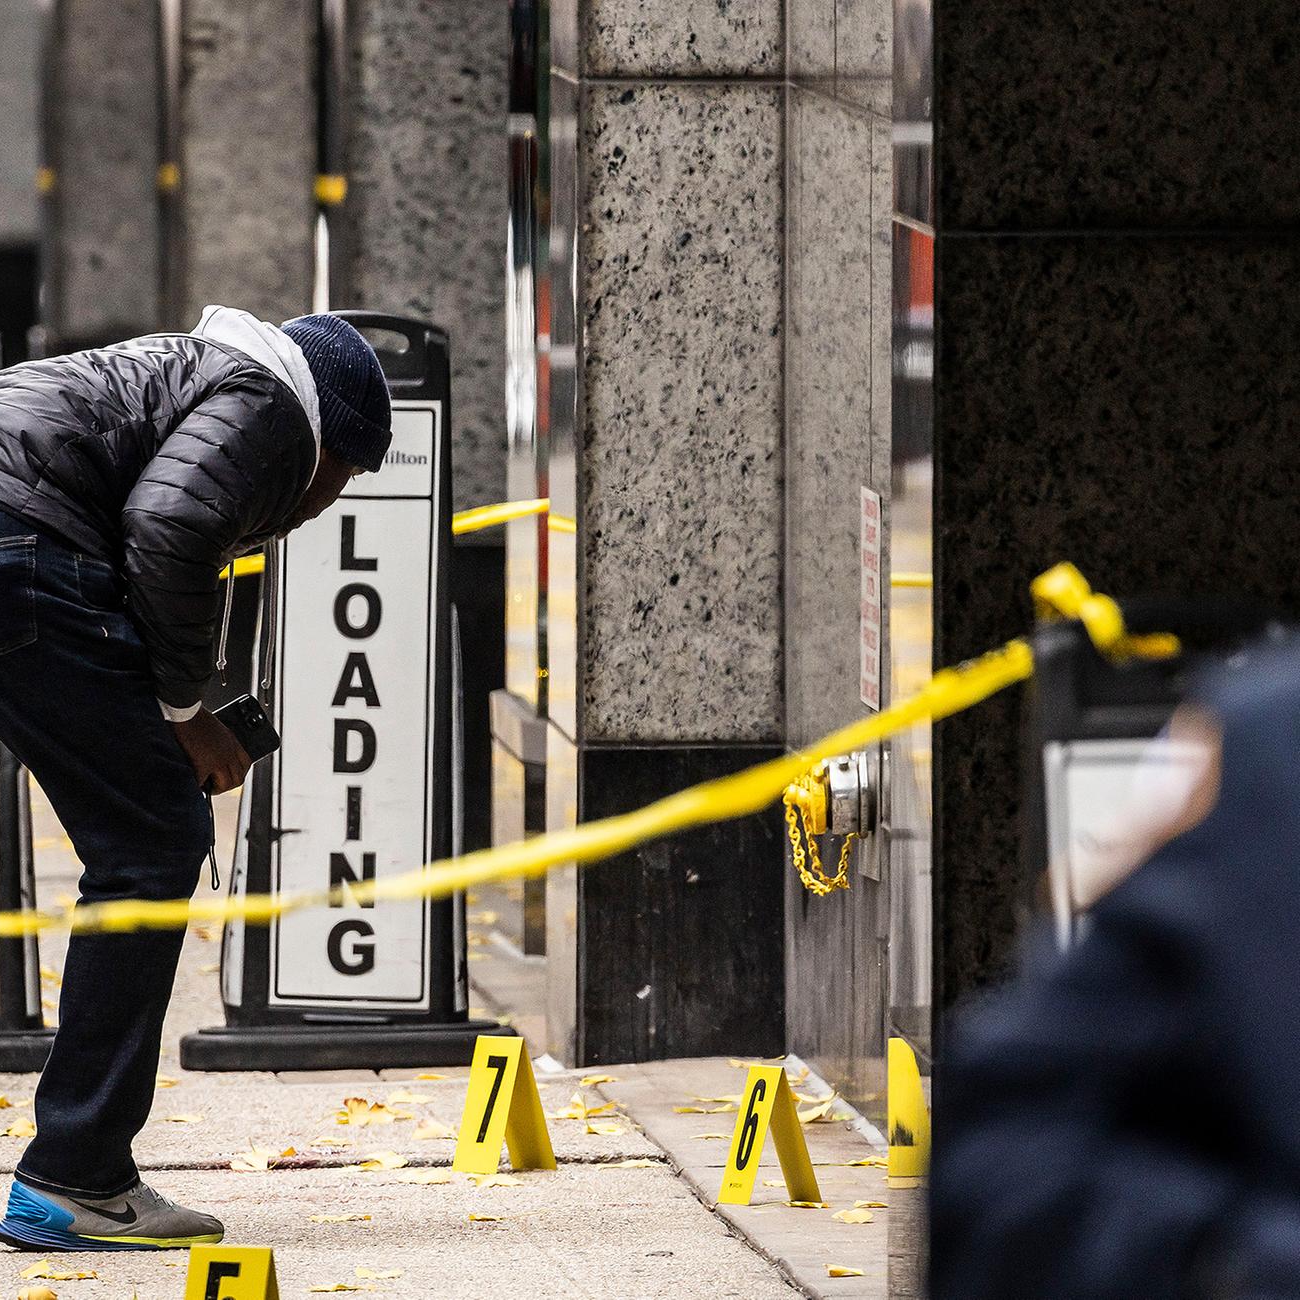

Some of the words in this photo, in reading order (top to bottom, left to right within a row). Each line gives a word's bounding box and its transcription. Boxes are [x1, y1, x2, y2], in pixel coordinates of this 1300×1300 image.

[326, 514, 383, 977] LOADING
[475, 1055, 509, 1144] 7
[735, 1078, 767, 1172] 6
